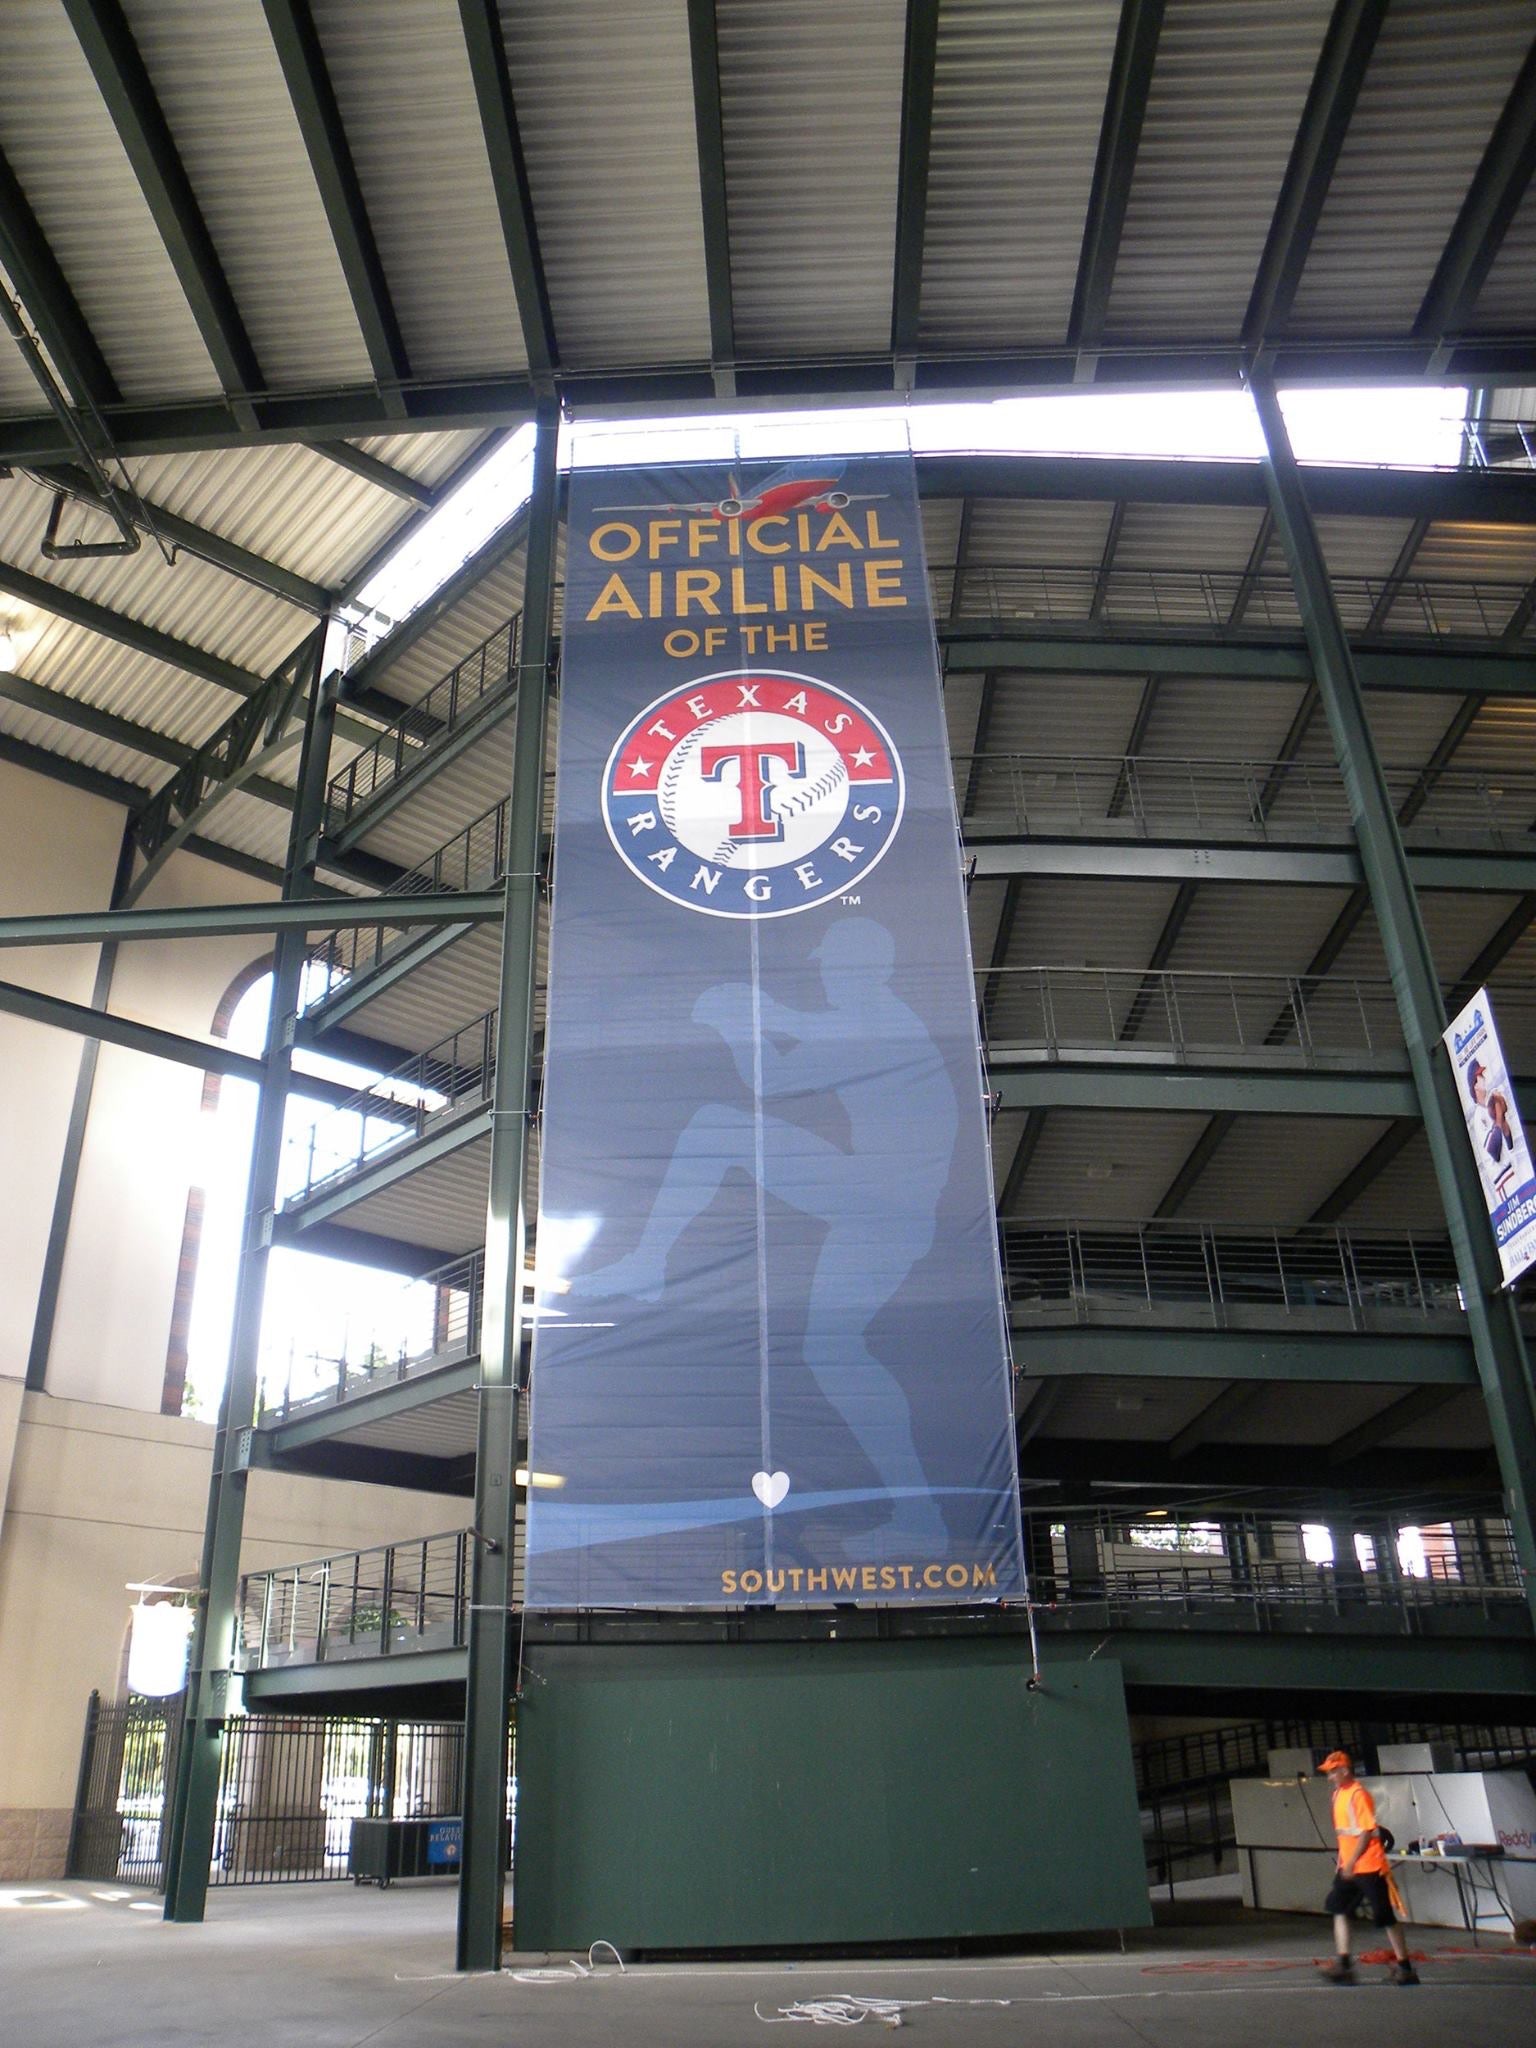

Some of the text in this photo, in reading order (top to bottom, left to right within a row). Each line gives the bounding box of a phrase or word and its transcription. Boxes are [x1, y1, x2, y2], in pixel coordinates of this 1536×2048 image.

[589, 510, 900, 562] OFFICIAL
[585, 560, 907, 621] AIRLINE
[663, 622, 829, 658] OF THE
[647, 683, 853, 743] TEXAS
[700, 740, 807, 845] T
[626, 803, 882, 902] RANGERS
[840, 896, 861, 906] TM
[1507, 1194, 1520, 1215] JIM
[721, 1562, 998, 1594] SOUTHWEST.COM
[1497, 1829, 1531, 1849] Reddy
